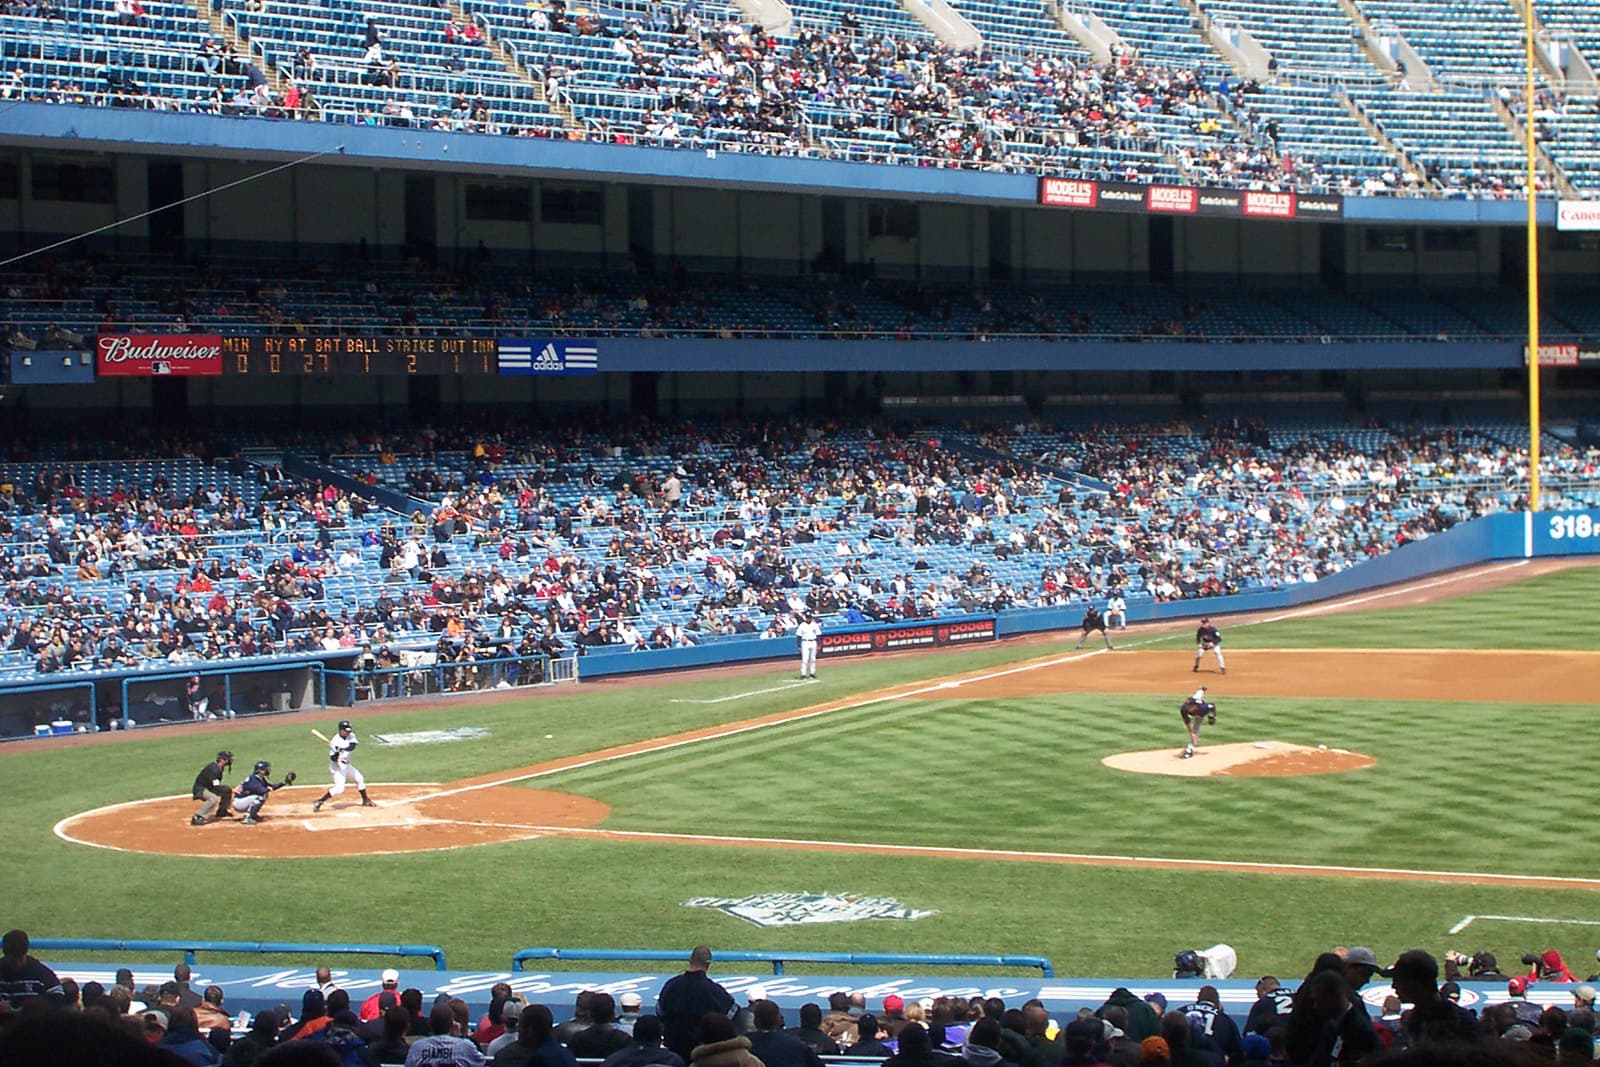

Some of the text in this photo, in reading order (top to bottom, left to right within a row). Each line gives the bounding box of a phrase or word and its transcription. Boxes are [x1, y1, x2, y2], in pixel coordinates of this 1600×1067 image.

[1046, 180, 1091, 197] MODELL'S
[1151, 188, 1193, 203] MODELL'S
[1247, 192, 1290, 208] MODELL'S
[99, 337, 220, 362] Budweiser
[223, 338, 494, 352] MIN NY AT BAT BALL STRIKE OUT INN
[238, 354, 248, 372] 0
[270, 354, 280, 372] 0
[303, 354, 328, 372] 27
[407, 354, 417, 373] 2
[533, 360, 564, 371] adidas
[1549, 514, 1592, 539] 318
[888, 627, 933, 639] DODGE
[950, 621, 993, 633] DODGE
[823, 633, 870, 646] DODGE
[1274, 995, 1293, 1015] 2
[422, 1047, 453, 1060] GIAMBI
